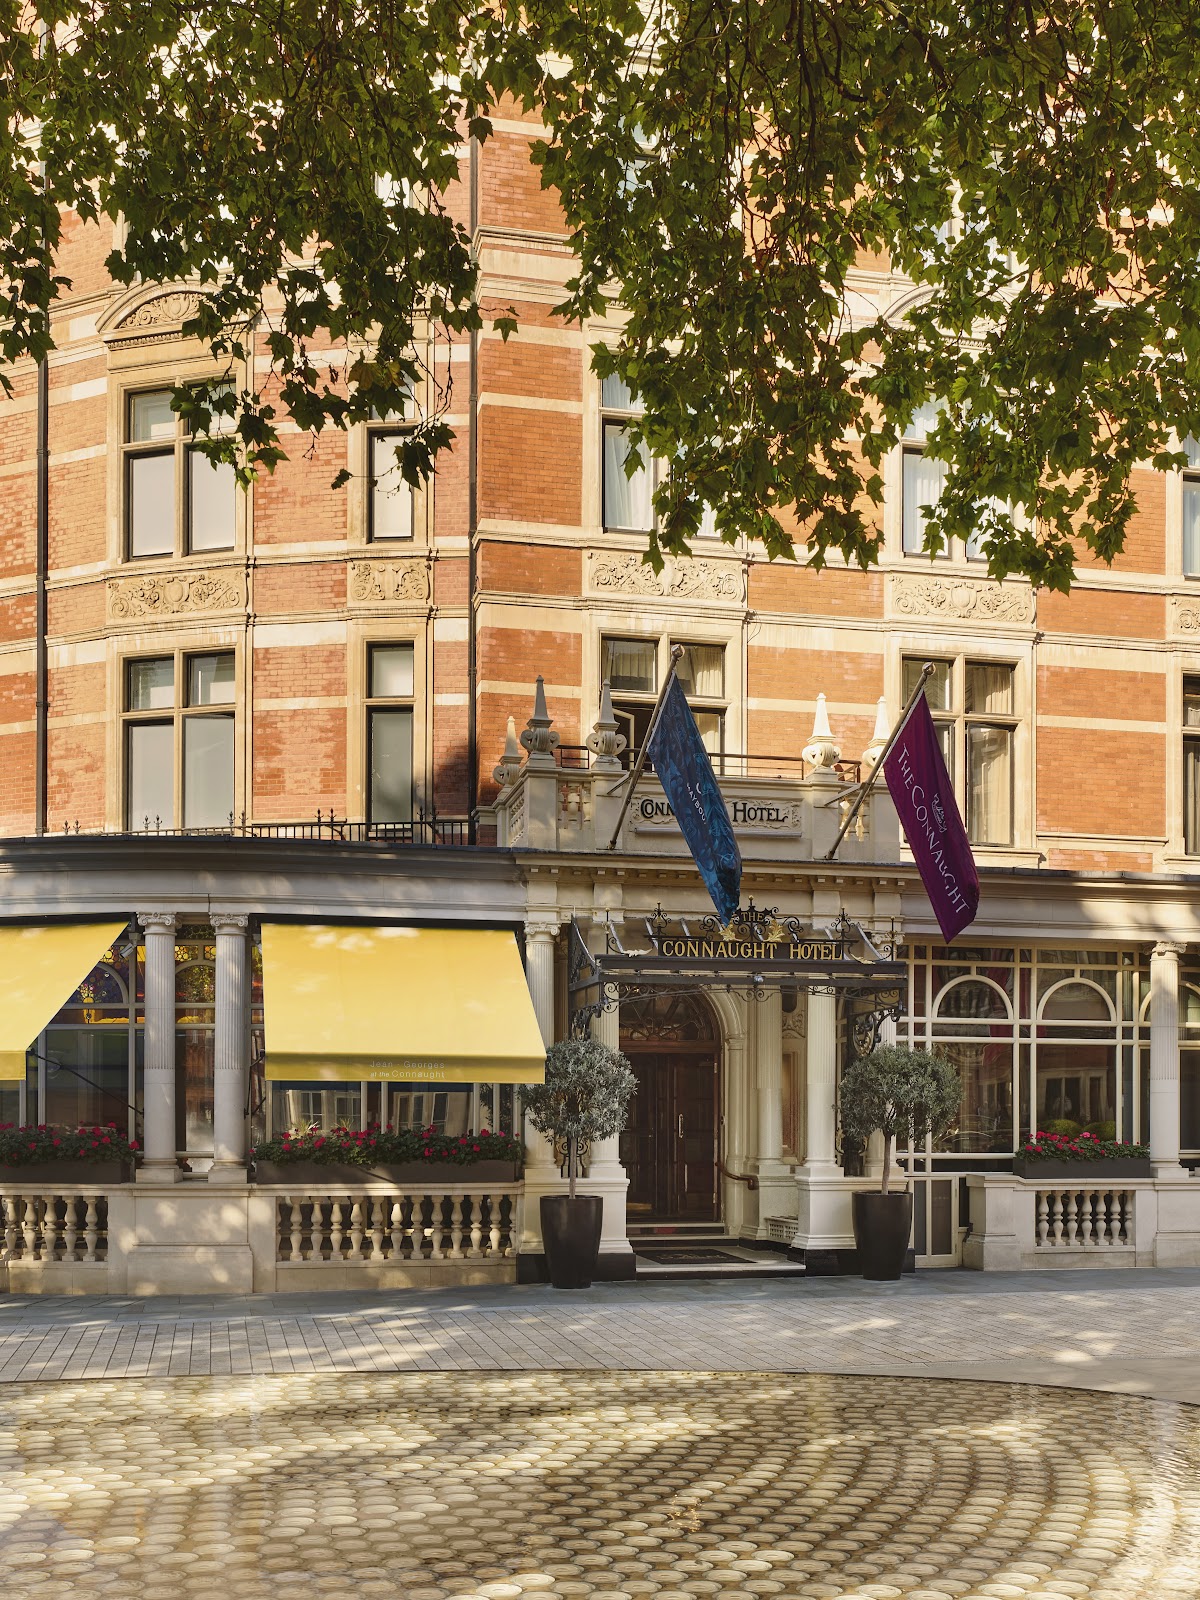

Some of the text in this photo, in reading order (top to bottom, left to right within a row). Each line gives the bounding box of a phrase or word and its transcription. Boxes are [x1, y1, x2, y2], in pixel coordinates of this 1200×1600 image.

[732, 801, 789, 823] HOTEL
[898, 743, 970, 913] THE CONNAUGHT
[740, 911, 765, 923] THE
[662, 940, 843, 961] CONNAUGHT HOTEL
[379, 1070, 390, 1078] the
[391, 1070, 445, 1079] Connaught
